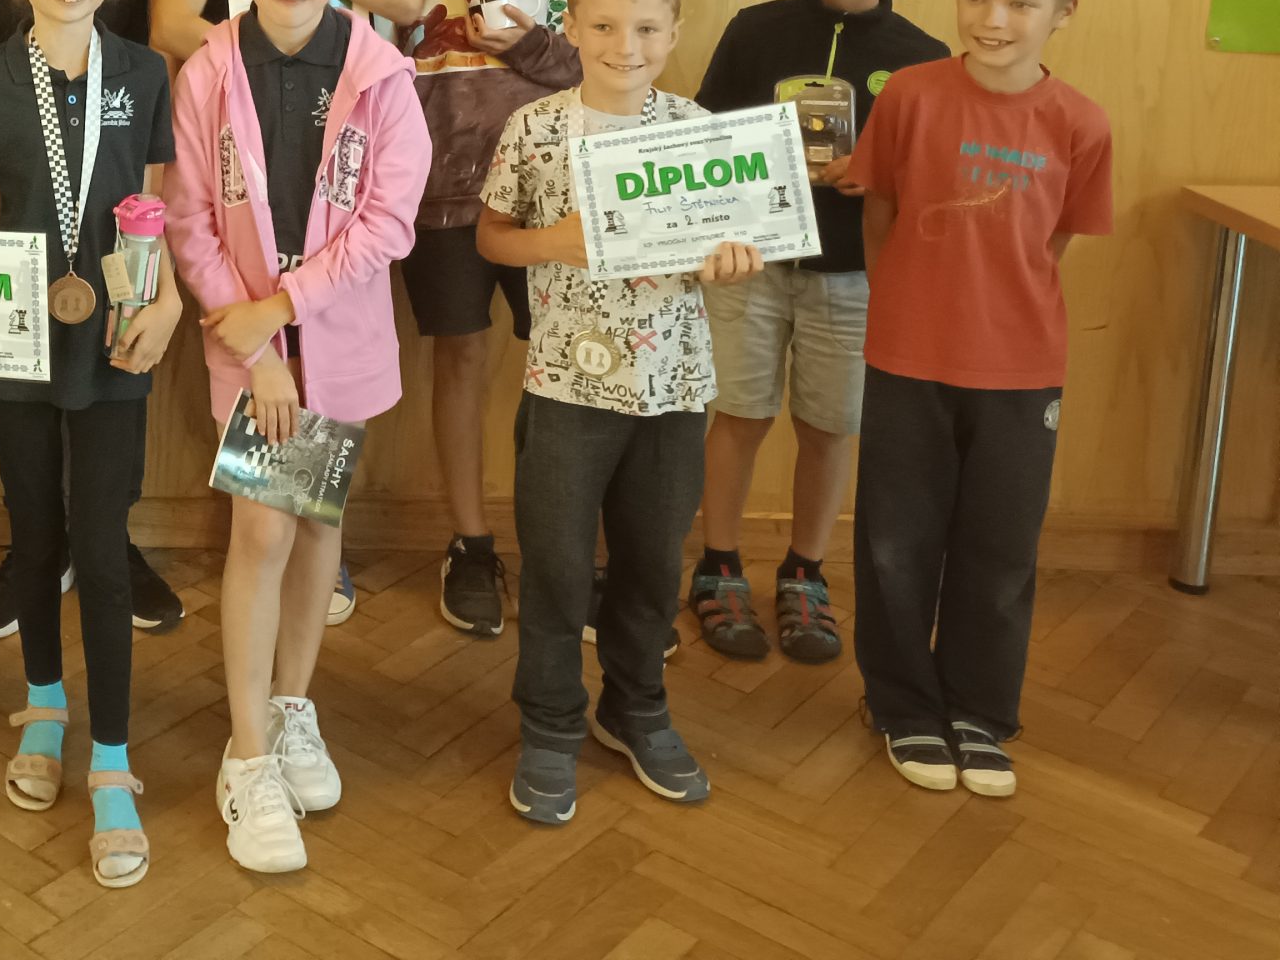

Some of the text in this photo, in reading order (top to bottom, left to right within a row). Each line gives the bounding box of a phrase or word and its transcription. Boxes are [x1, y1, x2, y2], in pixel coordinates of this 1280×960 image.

[615, 152, 769, 201] DIPLOM
[666, 221, 678, 229] za
[702, 213, 730, 224] místo
[330, 438, 355, 488] ŠACHY
